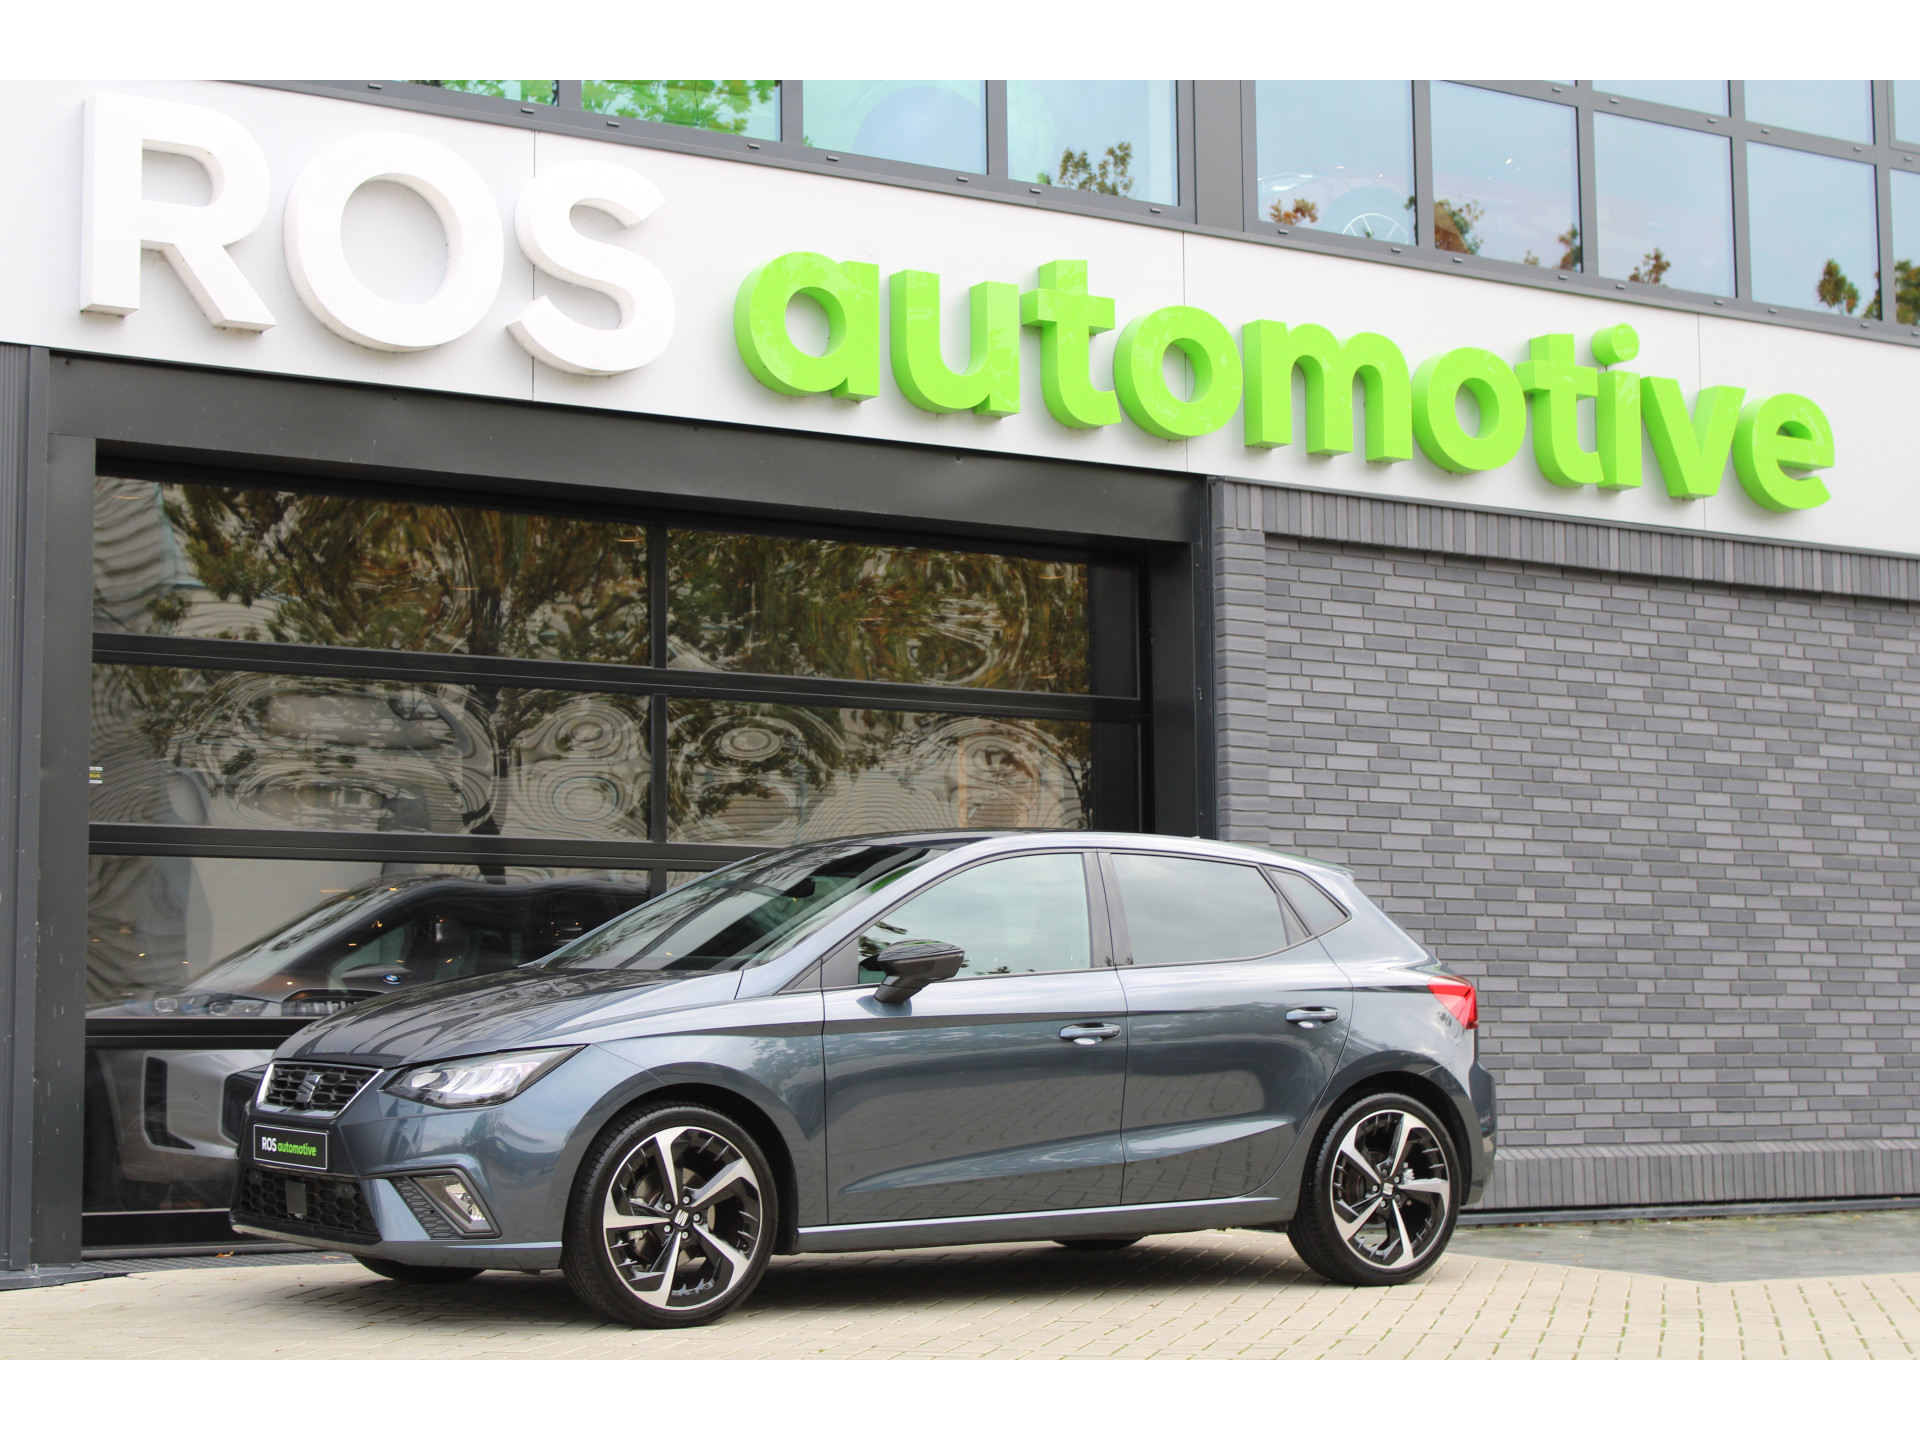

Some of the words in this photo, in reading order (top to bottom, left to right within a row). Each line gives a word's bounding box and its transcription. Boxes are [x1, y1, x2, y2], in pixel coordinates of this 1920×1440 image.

[80, 93, 676, 376] ROS
[734, 251, 1835, 513] automotive
[261, 1136, 277, 1152] ROS
[277, 1141, 317, 1157] automotive
